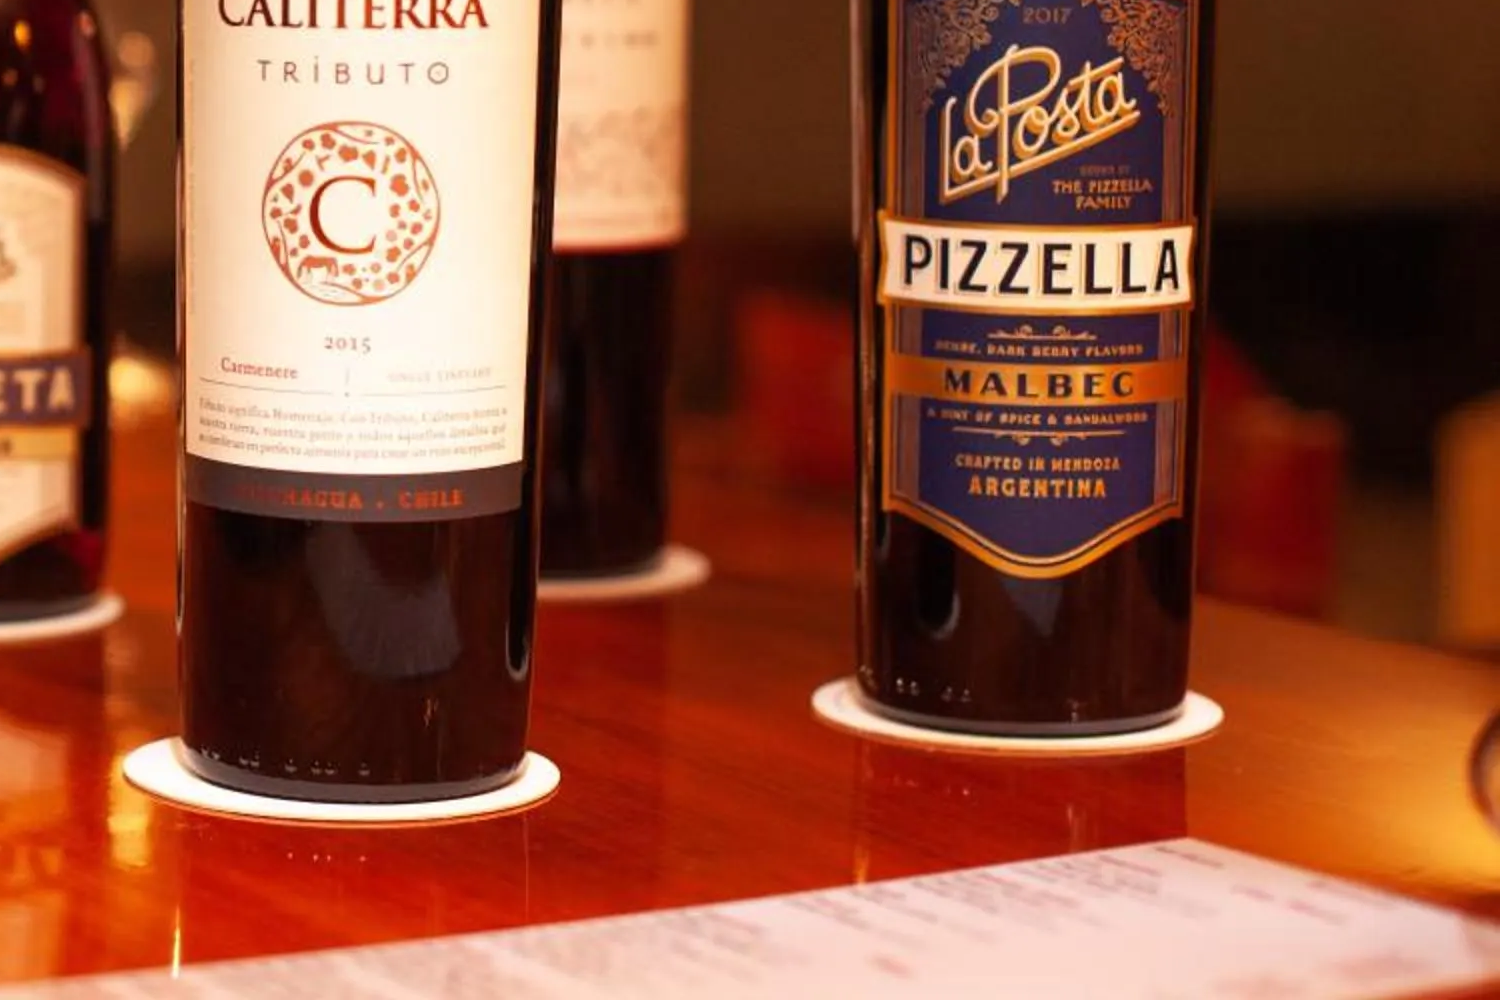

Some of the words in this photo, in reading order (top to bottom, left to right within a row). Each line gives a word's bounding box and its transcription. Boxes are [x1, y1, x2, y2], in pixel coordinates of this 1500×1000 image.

[1022, 6, 1072, 24] 2017
[964, 43, 1138, 204] Posta
[1052, 179, 1083, 193] THE
[1088, 178, 1154, 193] PIZZELLA
[1075, 195, 1133, 211] FAMILY
[309, 175, 377, 255] C
[904, 234, 1180, 295] PIZZELLA
[323, 336, 373, 353] 2015
[1031, 346, 1080, 357] BERRY
[1085, 344, 1143, 357] FLAVORS
[221, 356, 298, 380] Carmenere
[943, 367, 1135, 399] MALBEC
[975, 410, 994, 423] OF
[999, 412, 1041, 425] SPICE
[955, 453, 1023, 471] CRAFTED
[1029, 456, 1045, 472] IN
[1051, 456, 1121, 472] MENDOZA
[968, 474, 1107, 498] ARGENTINA
[399, 488, 465, 510] CHILE
